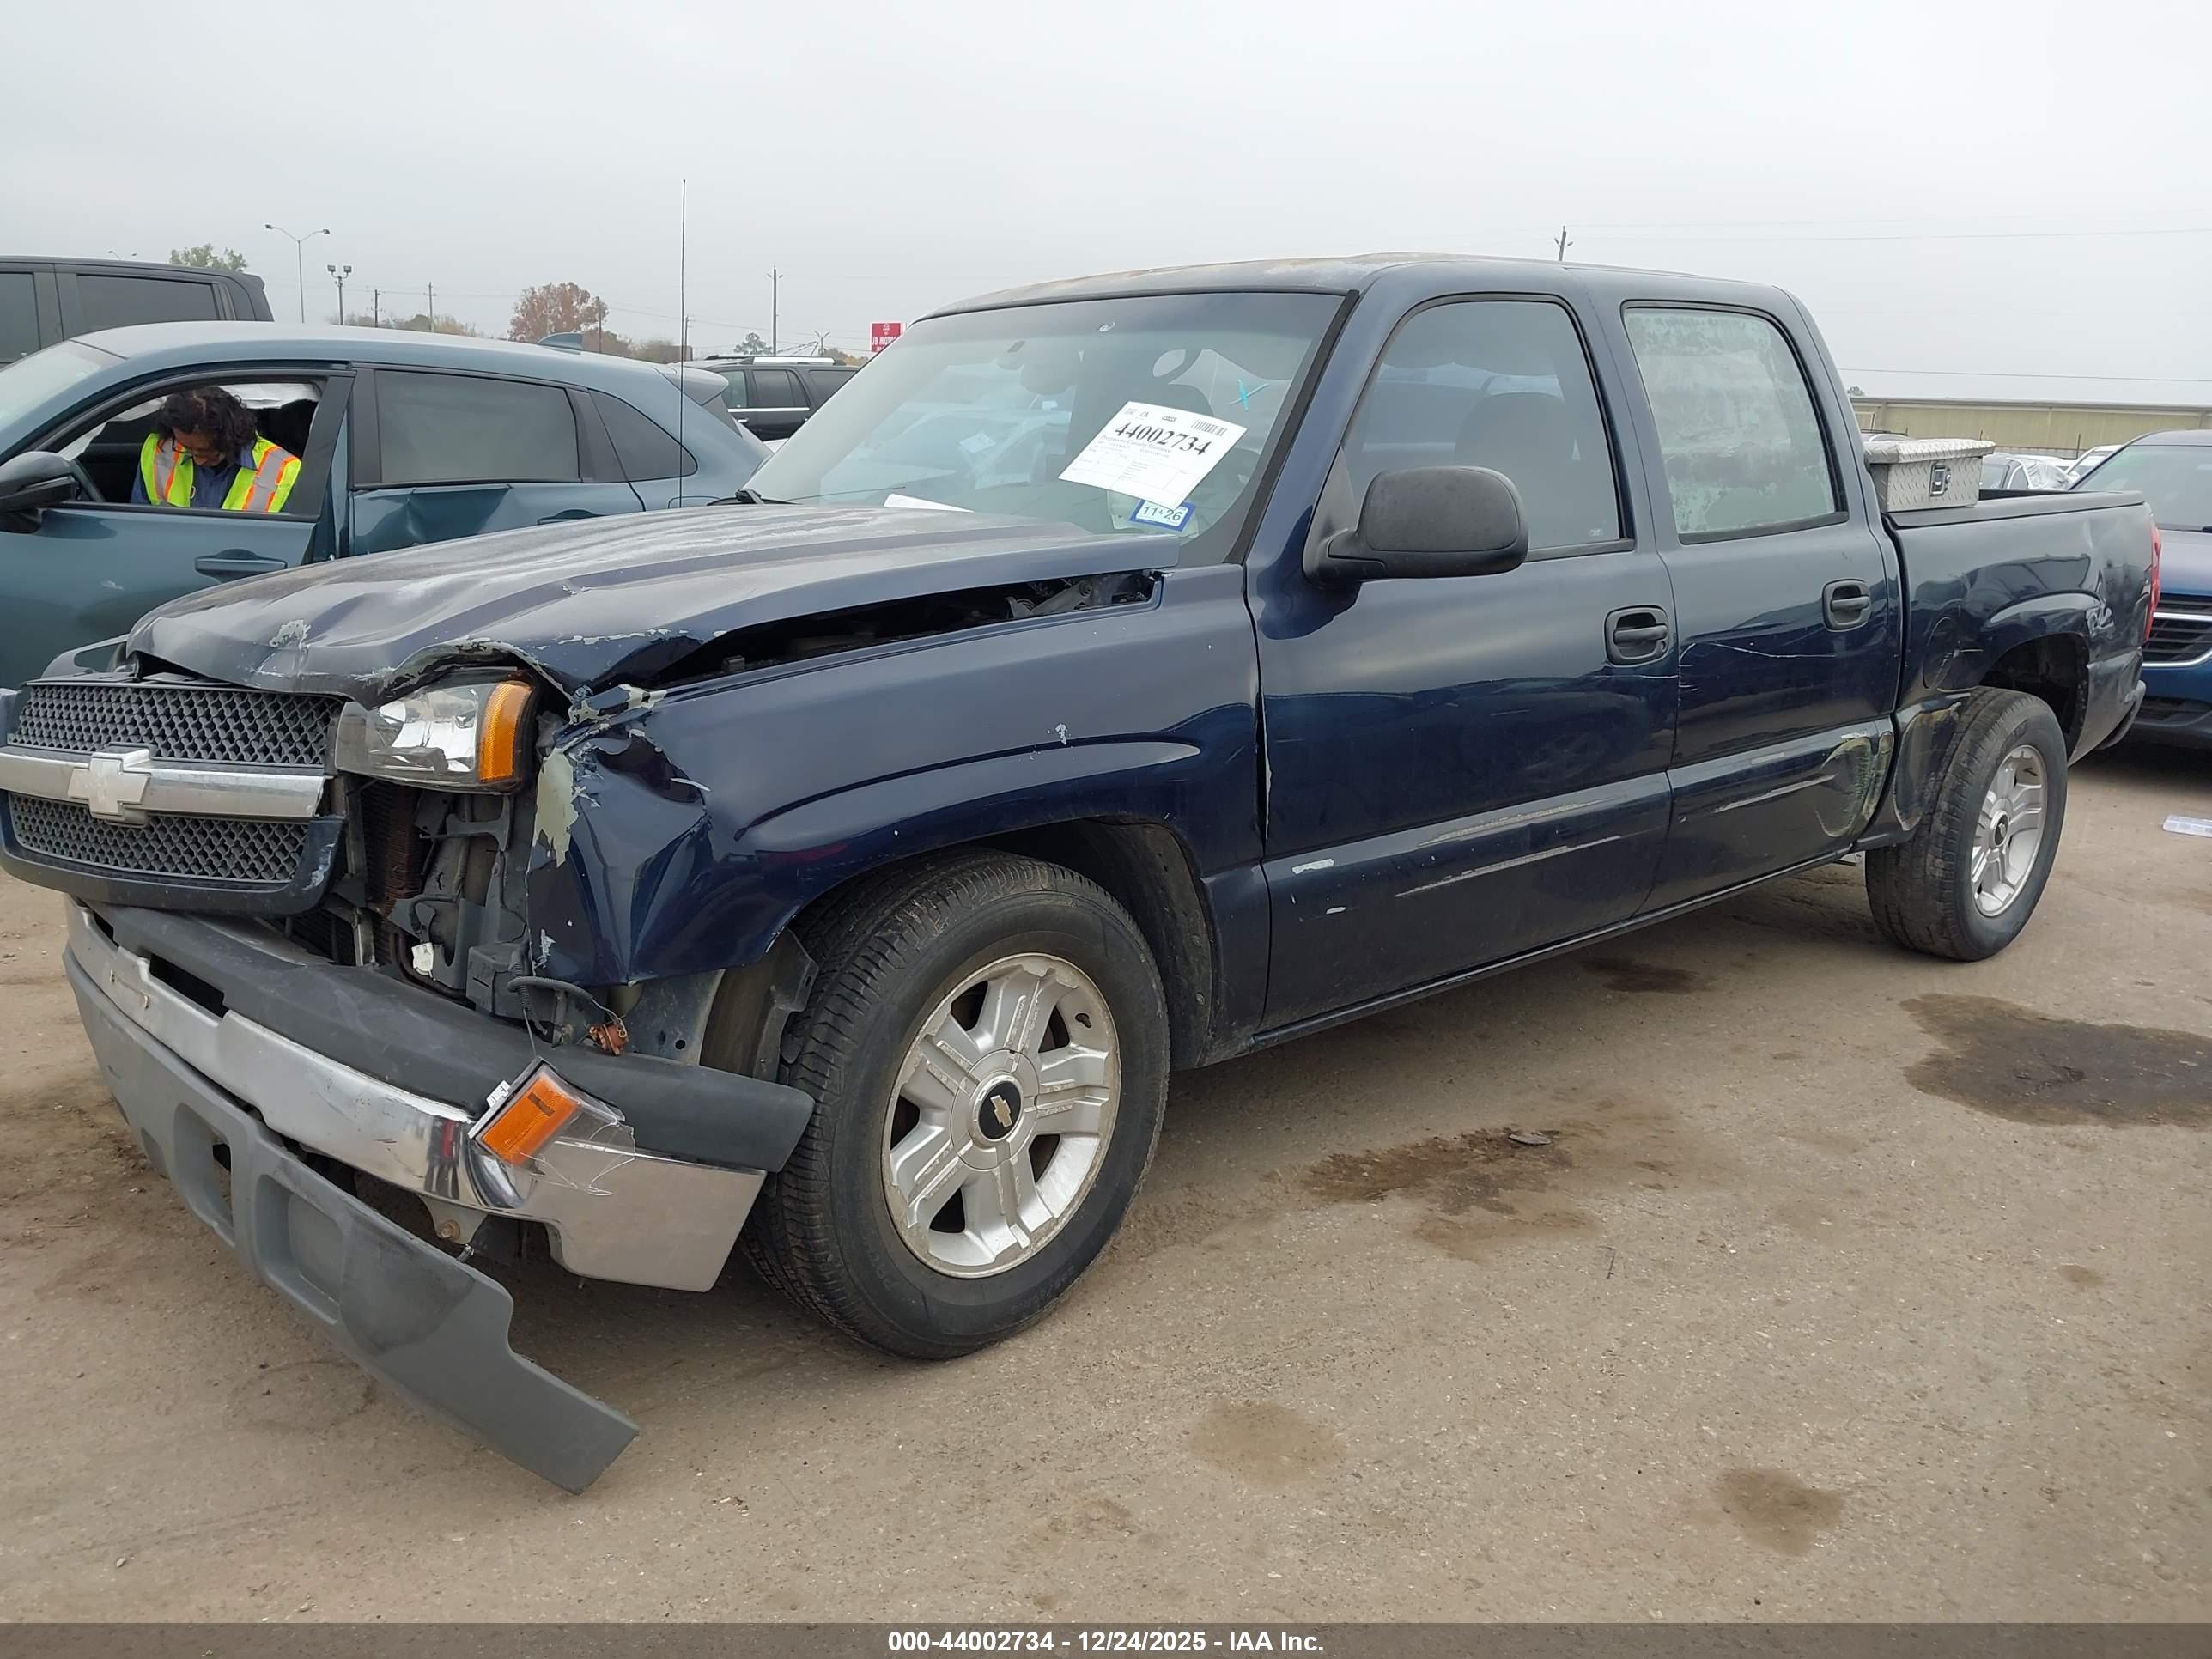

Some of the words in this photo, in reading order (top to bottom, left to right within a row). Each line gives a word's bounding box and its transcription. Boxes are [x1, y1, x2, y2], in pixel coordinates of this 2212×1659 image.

[1115, 422, 1212, 455] 44002734
[1143, 506, 1158, 516] 11
[1164, 509, 1182, 521] 26
